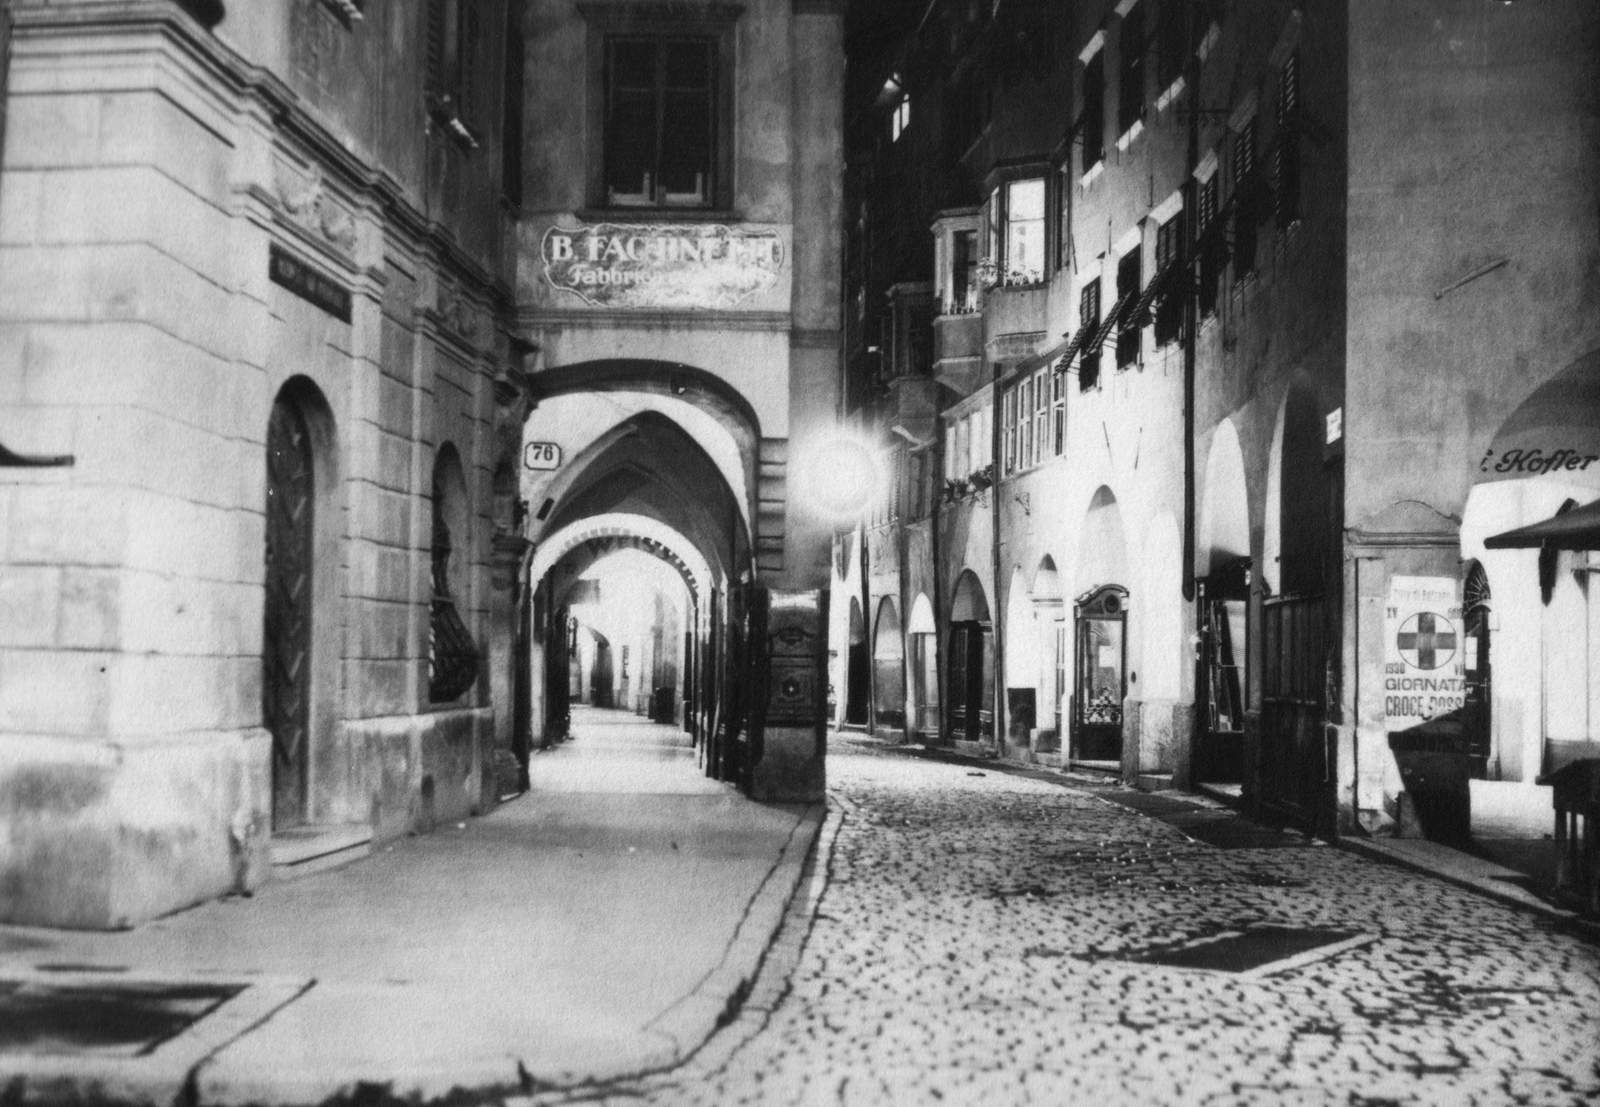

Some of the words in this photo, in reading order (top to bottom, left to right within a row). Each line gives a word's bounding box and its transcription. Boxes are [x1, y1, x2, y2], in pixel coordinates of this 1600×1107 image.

[550, 235, 579, 262] B.
[532, 445, 554, 461] 76
[1386, 607, 1398, 619] XV
[1385, 662, 1406, 675] 1930
[1385, 677, 1467, 692] GIORNATA
[1385, 695, 1423, 717] CROCE
